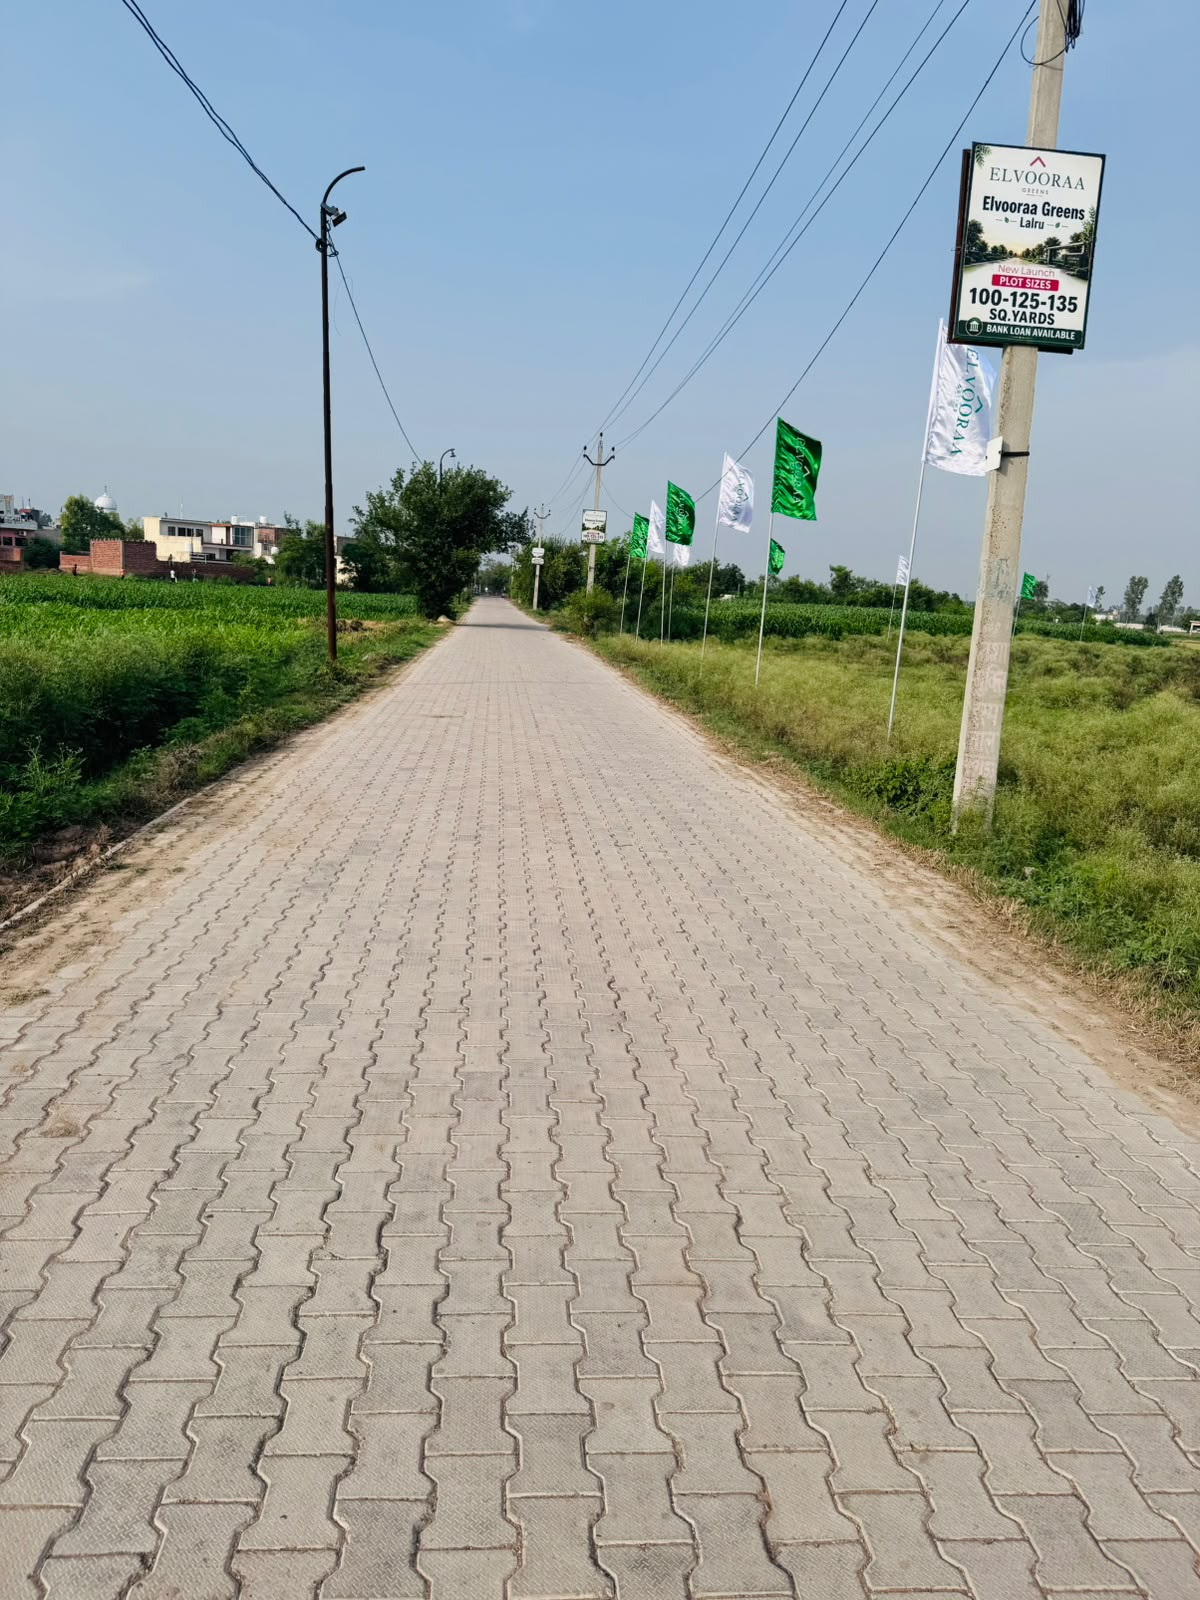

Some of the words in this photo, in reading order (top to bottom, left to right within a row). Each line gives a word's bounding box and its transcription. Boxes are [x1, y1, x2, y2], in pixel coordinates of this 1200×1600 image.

[990, 167, 1085, 190] ELVOORAA
[1021, 187, 1049, 195] GREENS
[982, 195, 1038, 216] Elvooraa
[1041, 201, 1085, 221] Greens
[998, 265, 1019, 275] New
[1021, 267, 1055, 278] Launch
[999, 277, 1023, 287] PLOT
[1025, 279, 1051, 290] SIZES
[969, 287, 1078, 313] 100-125-135
[989, 308, 1055, 326] SQ.YARDS
[986, 324, 1008, 334] BANK
[1010, 327, 1031, 336] LOAN
[1033, 329, 1075, 340] AVAILABLE
[950, 347, 978, 455] ELVOORAA
